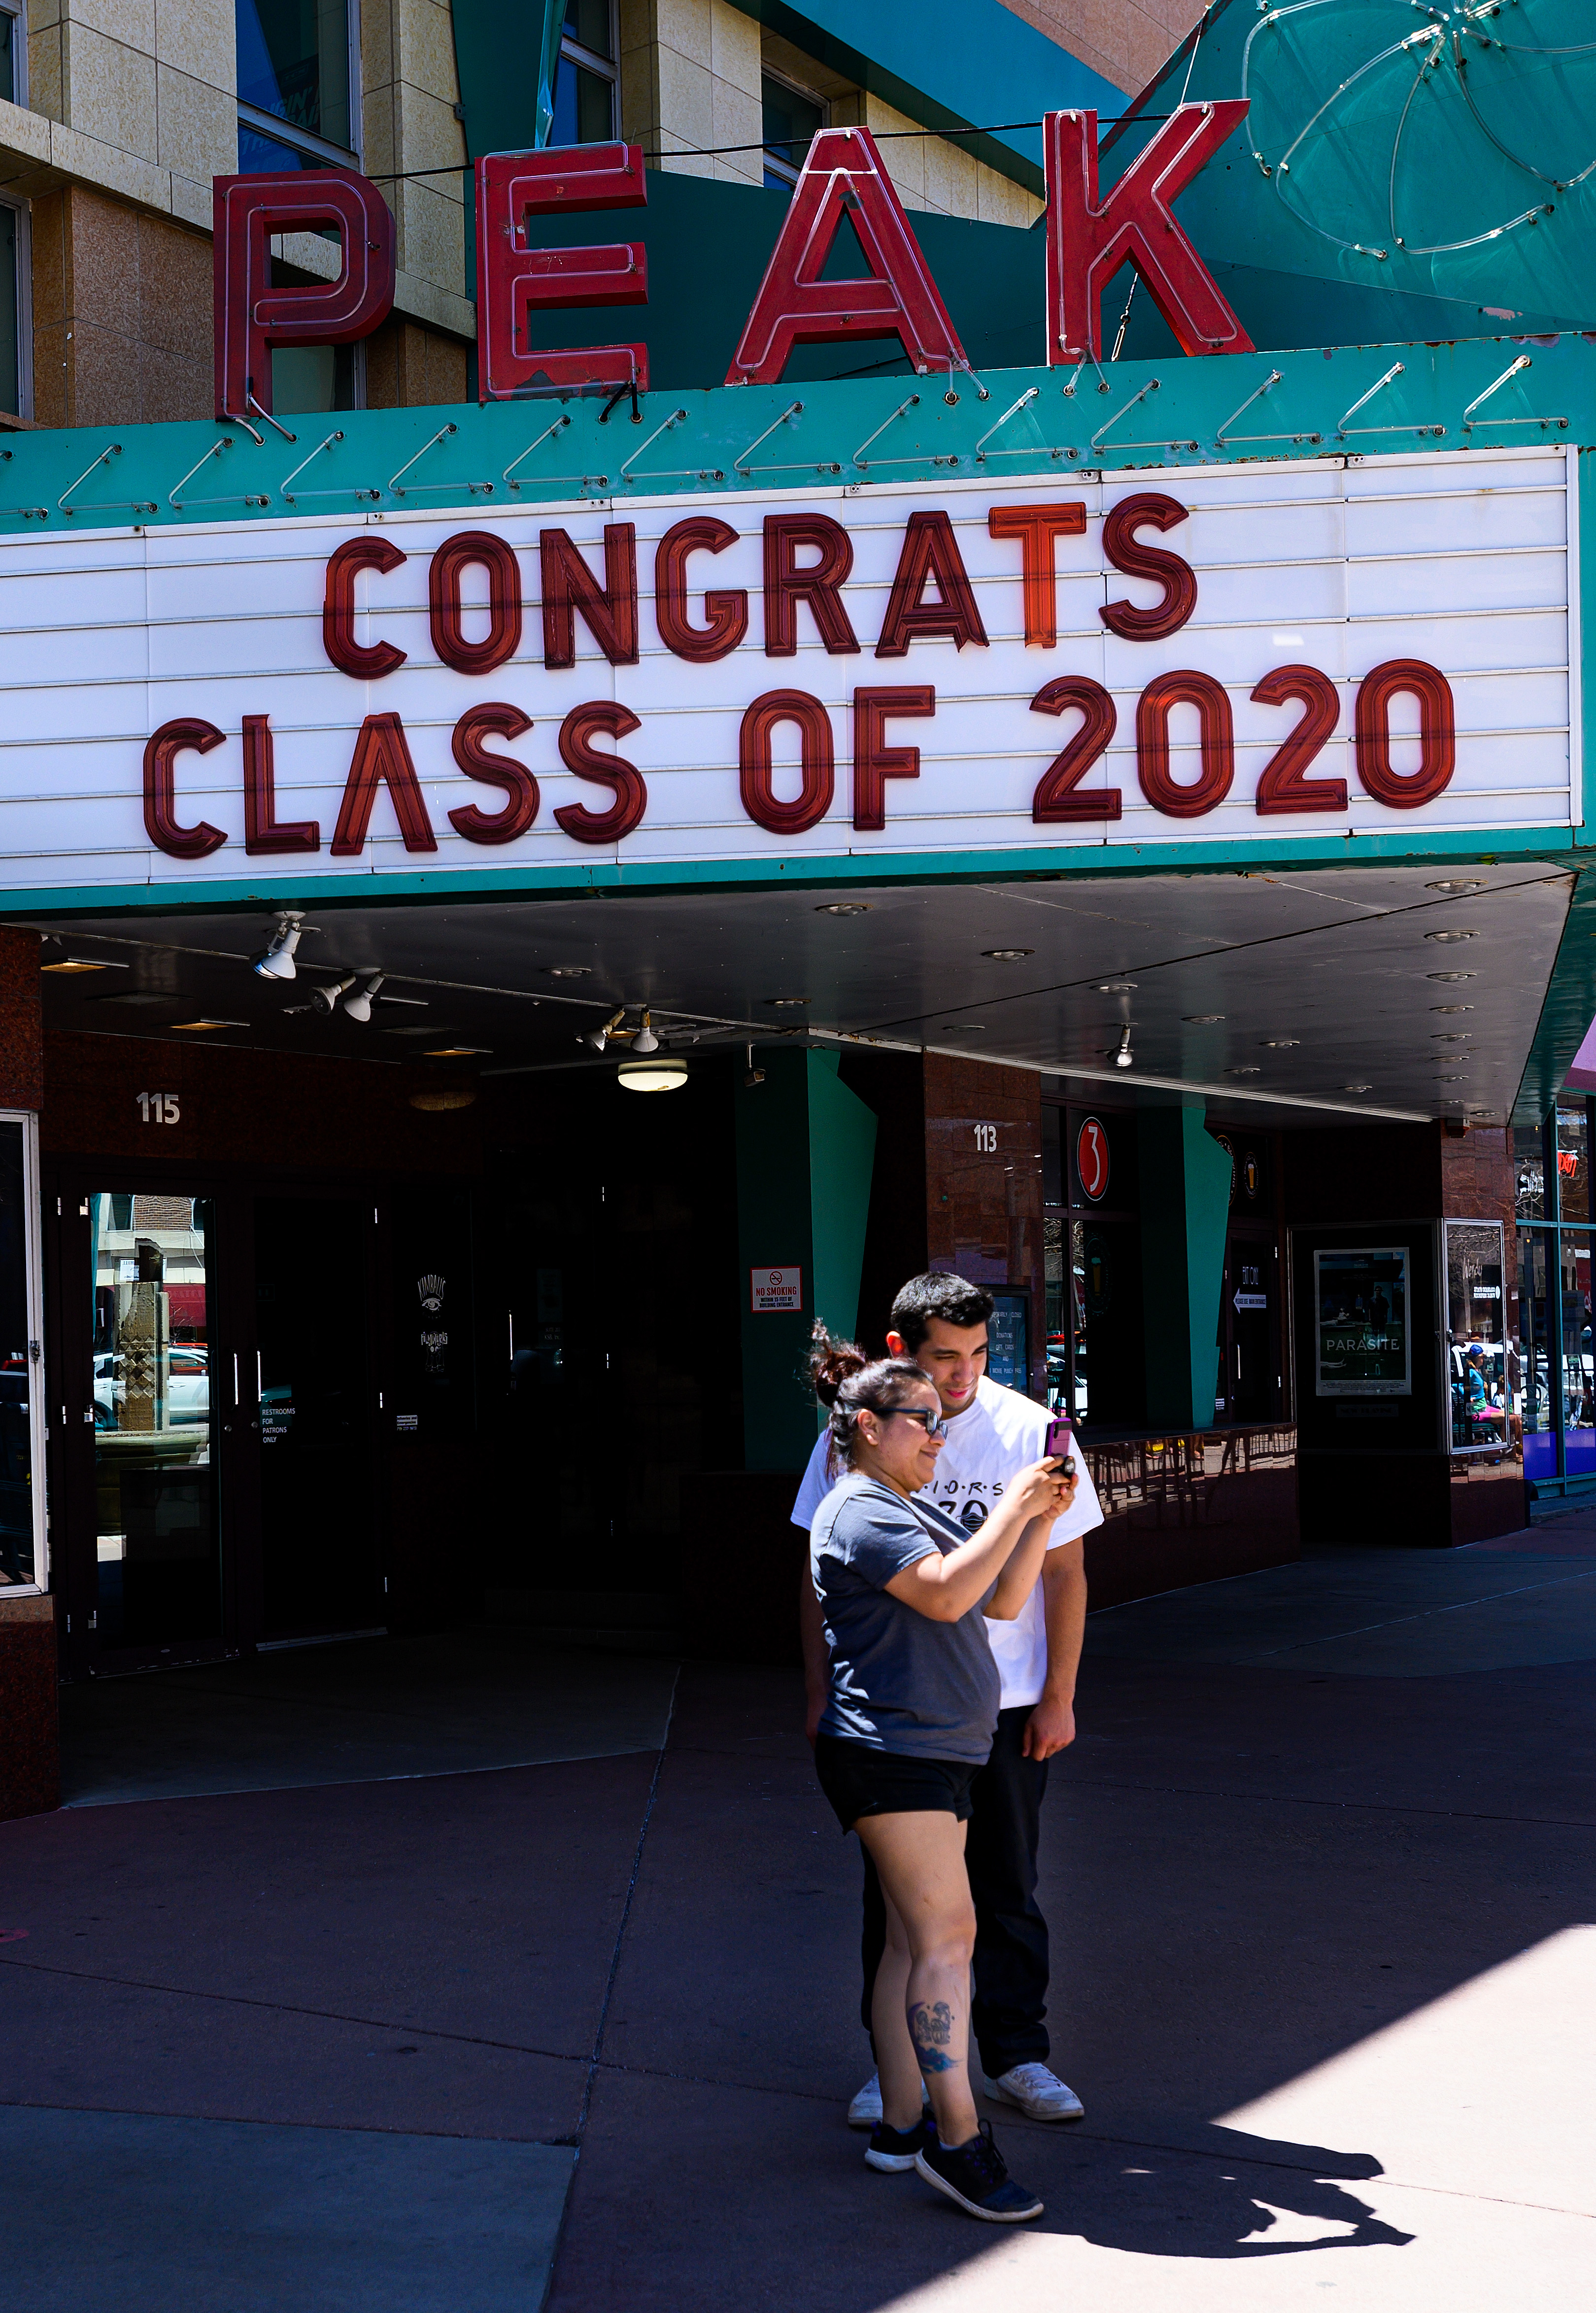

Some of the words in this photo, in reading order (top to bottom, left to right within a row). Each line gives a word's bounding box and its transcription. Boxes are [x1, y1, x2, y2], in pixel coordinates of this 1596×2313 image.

[213, 98, 1256, 422] PEAK
[323, 492, 1197, 680] CONGRATS
[143, 700, 647, 860] CLASS
[739, 684, 936, 834] OF
[1029, 658, 1455, 824] 2020
[136, 1092, 180, 1124] 115
[974, 1124, 997, 1153] 113
[1557, 1152, 1577, 1177] pen
[756, 1287, 765, 1296] NO
[767, 1286, 797, 1296] SMOKING
[1326, 1339, 1400, 1351] PARASITE
